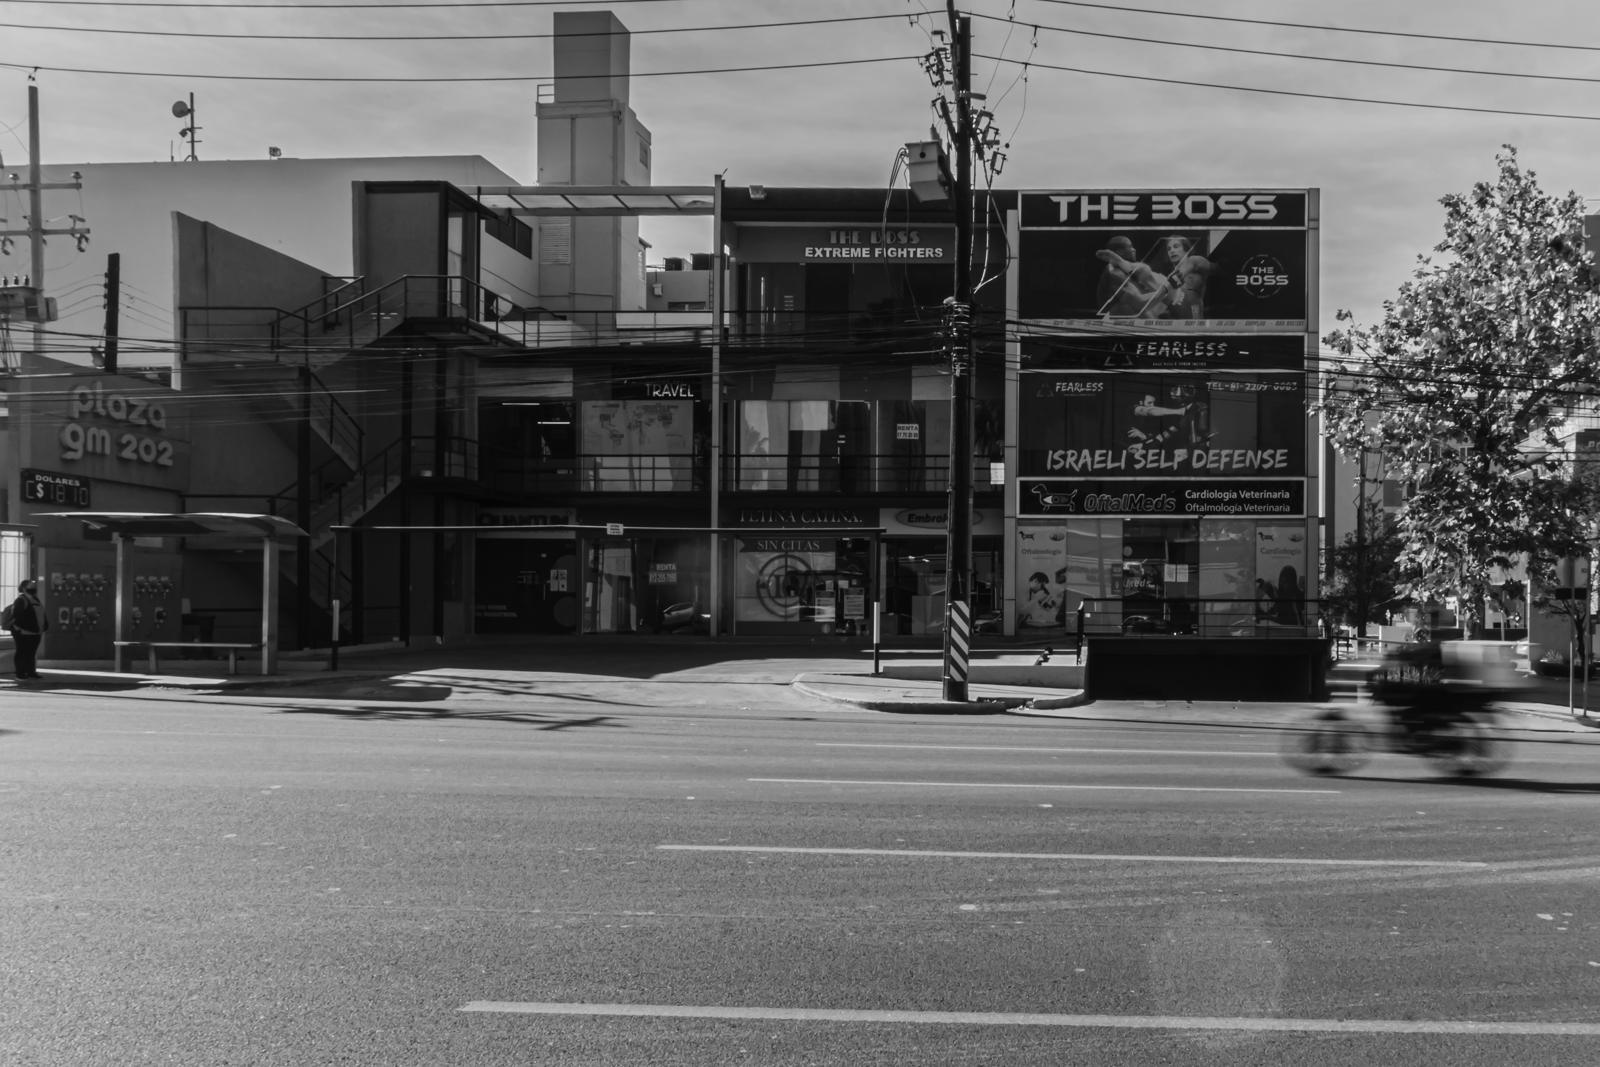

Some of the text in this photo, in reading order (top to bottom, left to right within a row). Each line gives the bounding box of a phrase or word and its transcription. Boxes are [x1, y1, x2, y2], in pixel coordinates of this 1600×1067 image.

[1049, 195, 1279, 223] THE BOSS
[829, 230, 862, 244] THE
[805, 247, 943, 258] EXTREME FIGHTERS
[1252, 266, 1274, 274] THE
[1235, 275, 1289, 286] BOSS
[1136, 341, 1229, 358] FEARLESS
[645, 383, 695, 398] TRAVEL
[1055, 382, 1104, 393] FEARLESS
[70, 381, 166, 429] plaza
[61, 423, 174, 467] gm 202
[1047, 449, 1126, 472] ISRAELI
[1192, 449, 1288, 470] DEFENSE
[35, 474, 80, 487] DOLARES
[1239, 490, 1290, 499] Veterinaria
[1084, 493, 1177, 513] OftalMeds
[1243, 503, 1290, 512] Veterinaria
